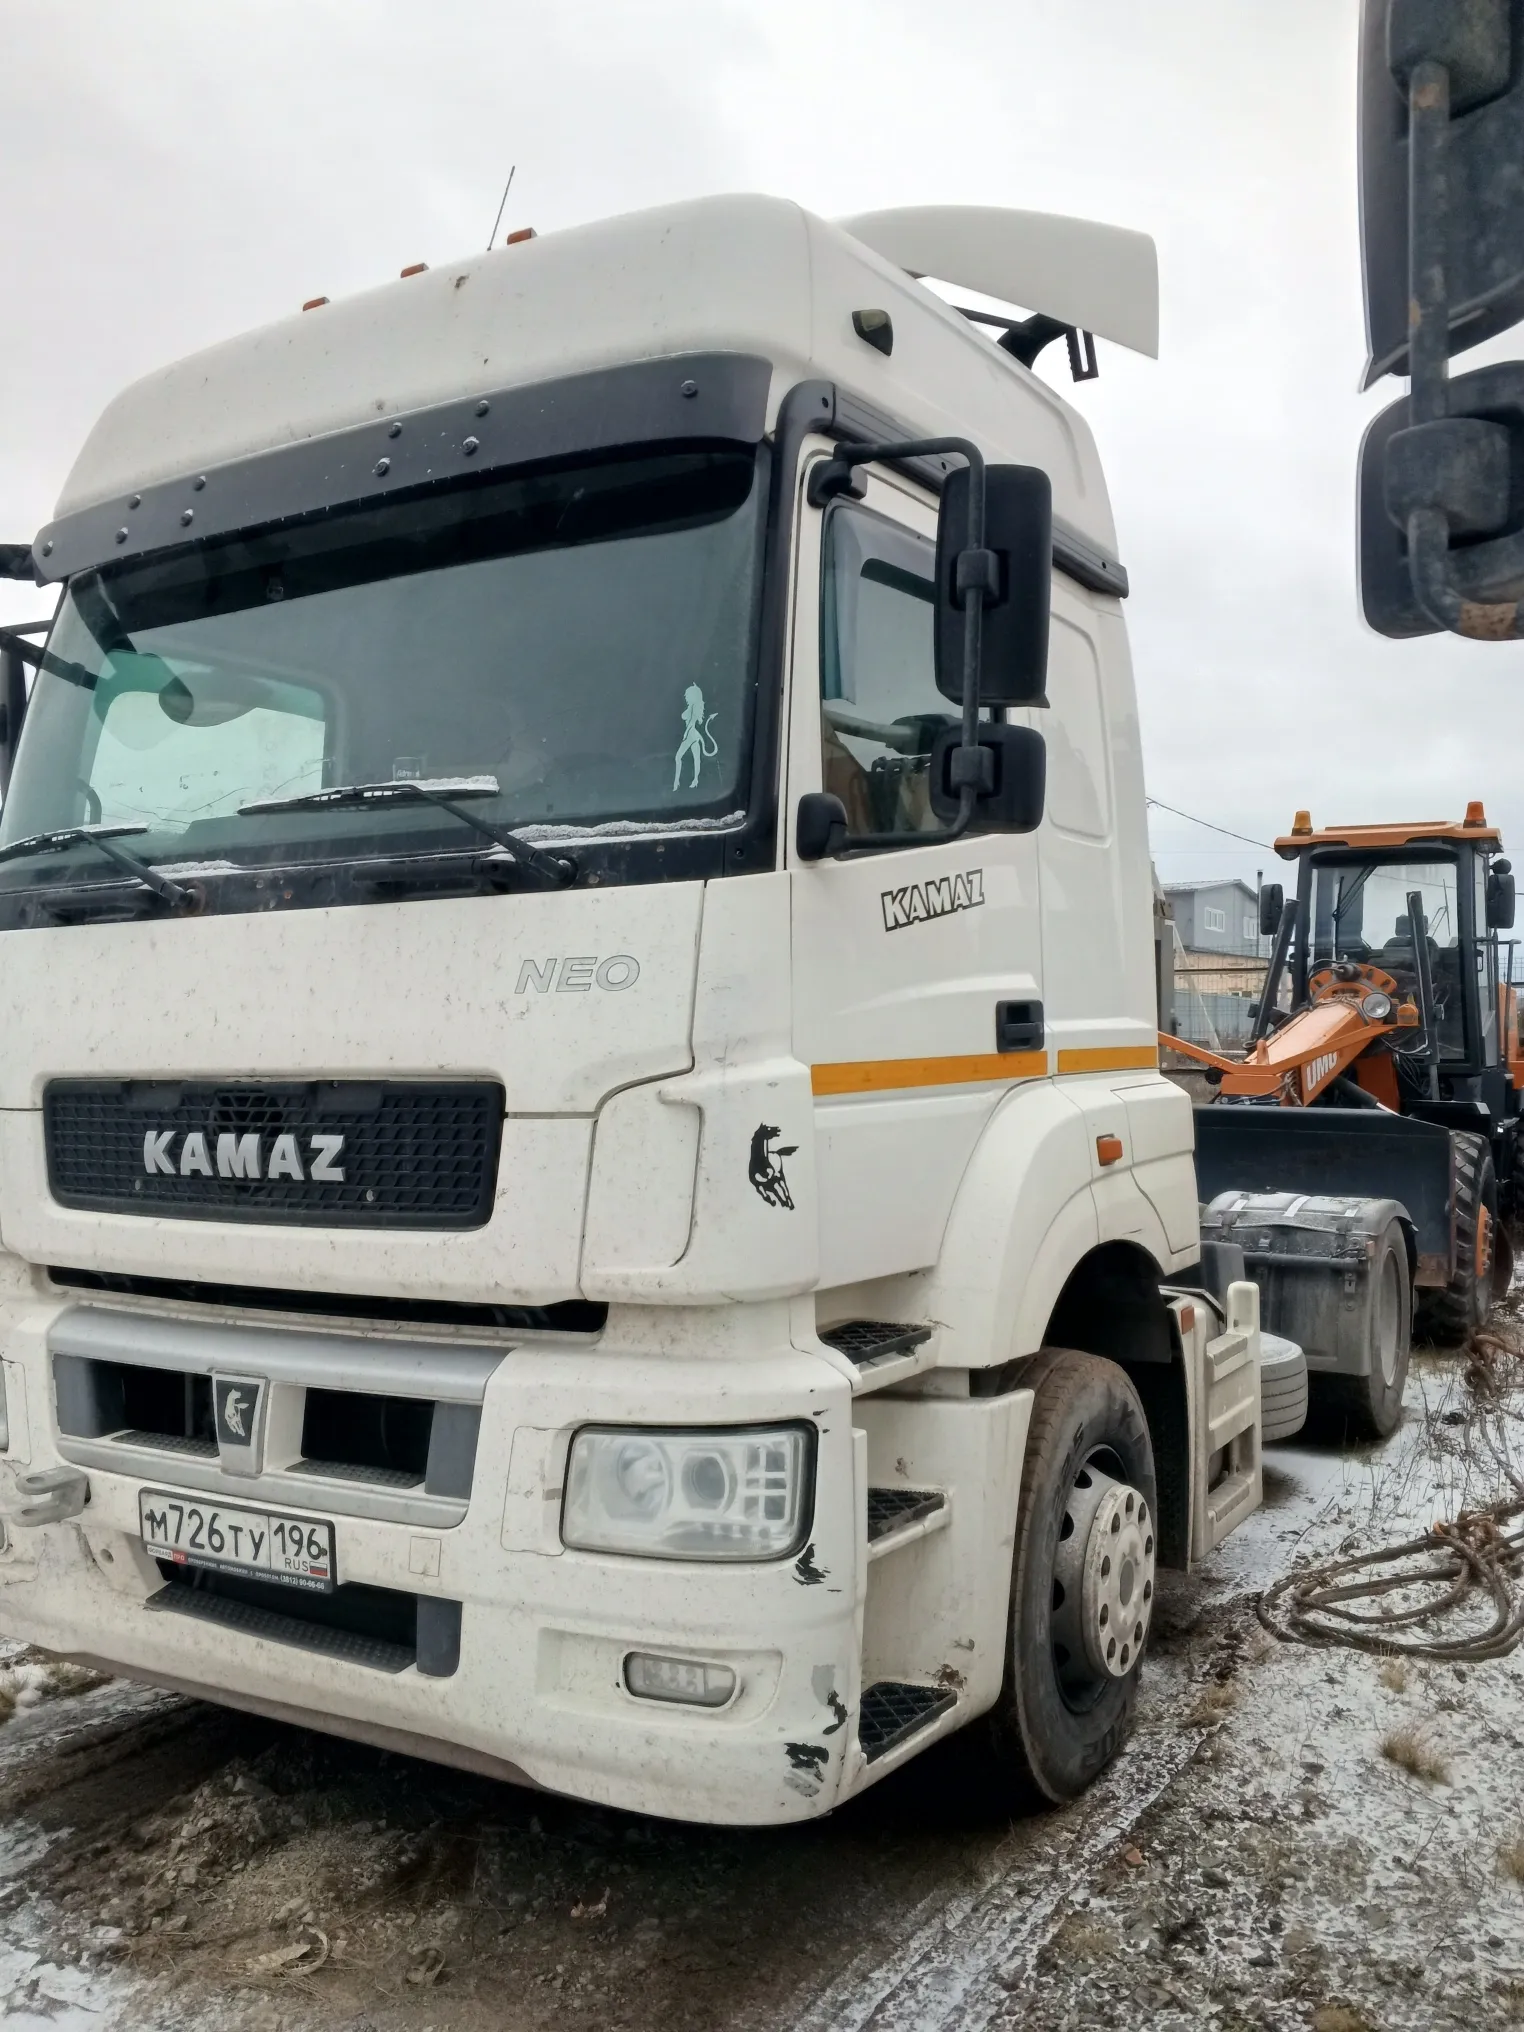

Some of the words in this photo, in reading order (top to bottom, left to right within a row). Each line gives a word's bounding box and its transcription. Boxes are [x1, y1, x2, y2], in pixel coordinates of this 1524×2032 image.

[881, 868, 985, 932] KAMAZ
[514, 955, 640, 994] NEO
[143, 1130, 346, 1181] KAMAZ
[274, 1522, 321, 1561] 196
[284, 1557, 309, 1572] RUS
